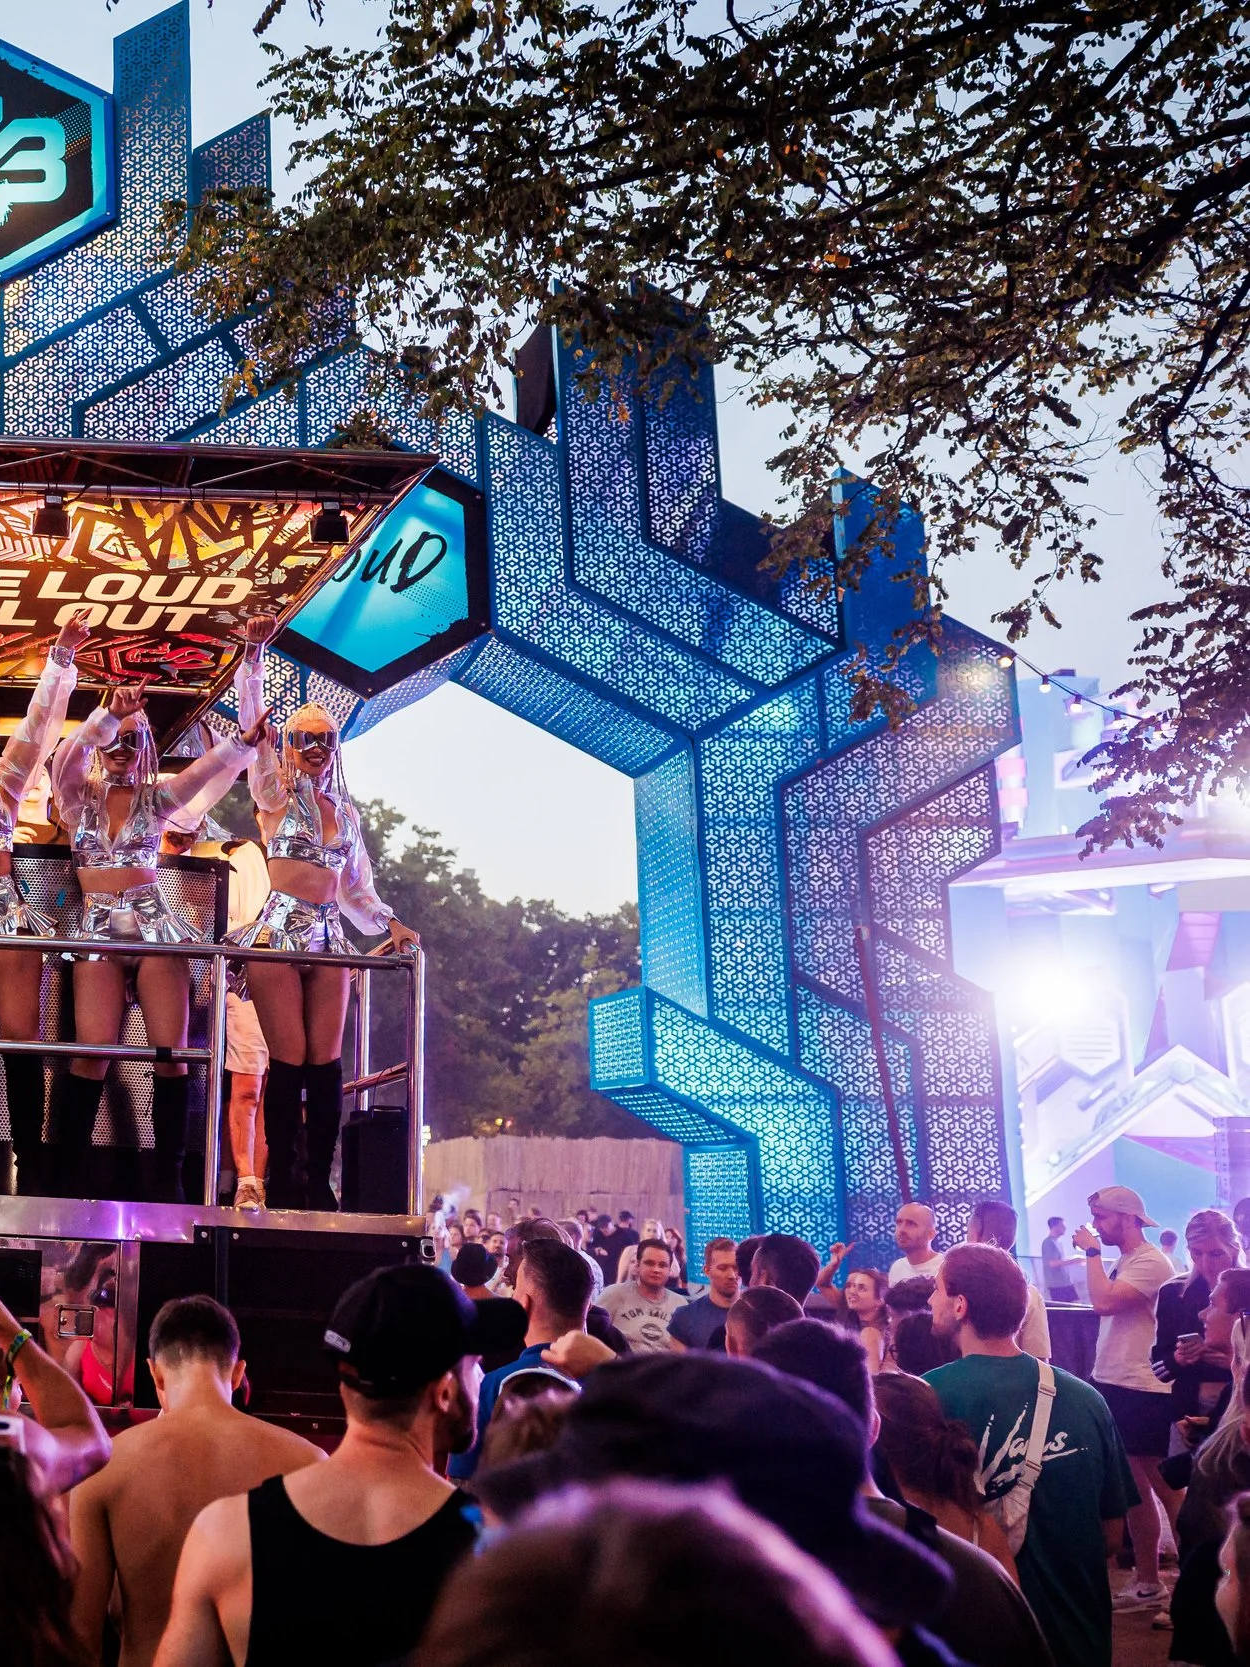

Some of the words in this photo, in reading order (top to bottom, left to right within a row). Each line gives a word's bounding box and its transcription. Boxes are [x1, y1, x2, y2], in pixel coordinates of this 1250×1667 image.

[36, 570, 254, 606] LOUD
[53, 602, 209, 632] OUT
[973, 1402, 1069, 1496] Vas
